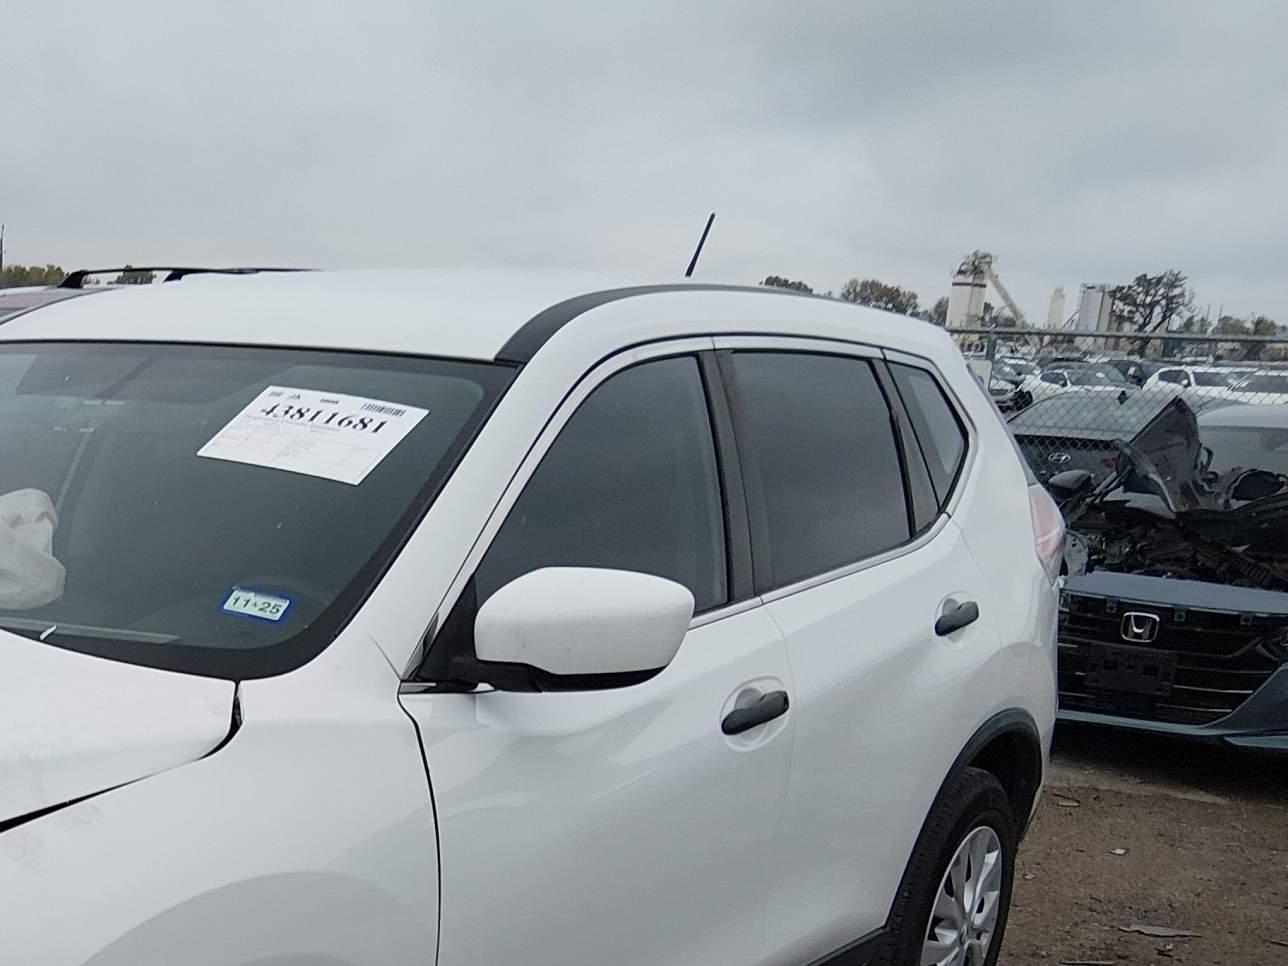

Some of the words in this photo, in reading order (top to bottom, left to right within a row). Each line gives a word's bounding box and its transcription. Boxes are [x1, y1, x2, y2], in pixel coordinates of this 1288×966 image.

[261, 402, 390, 434] 43811681
[232, 596, 251, 608] 11
[258, 601, 282, 615] 25
